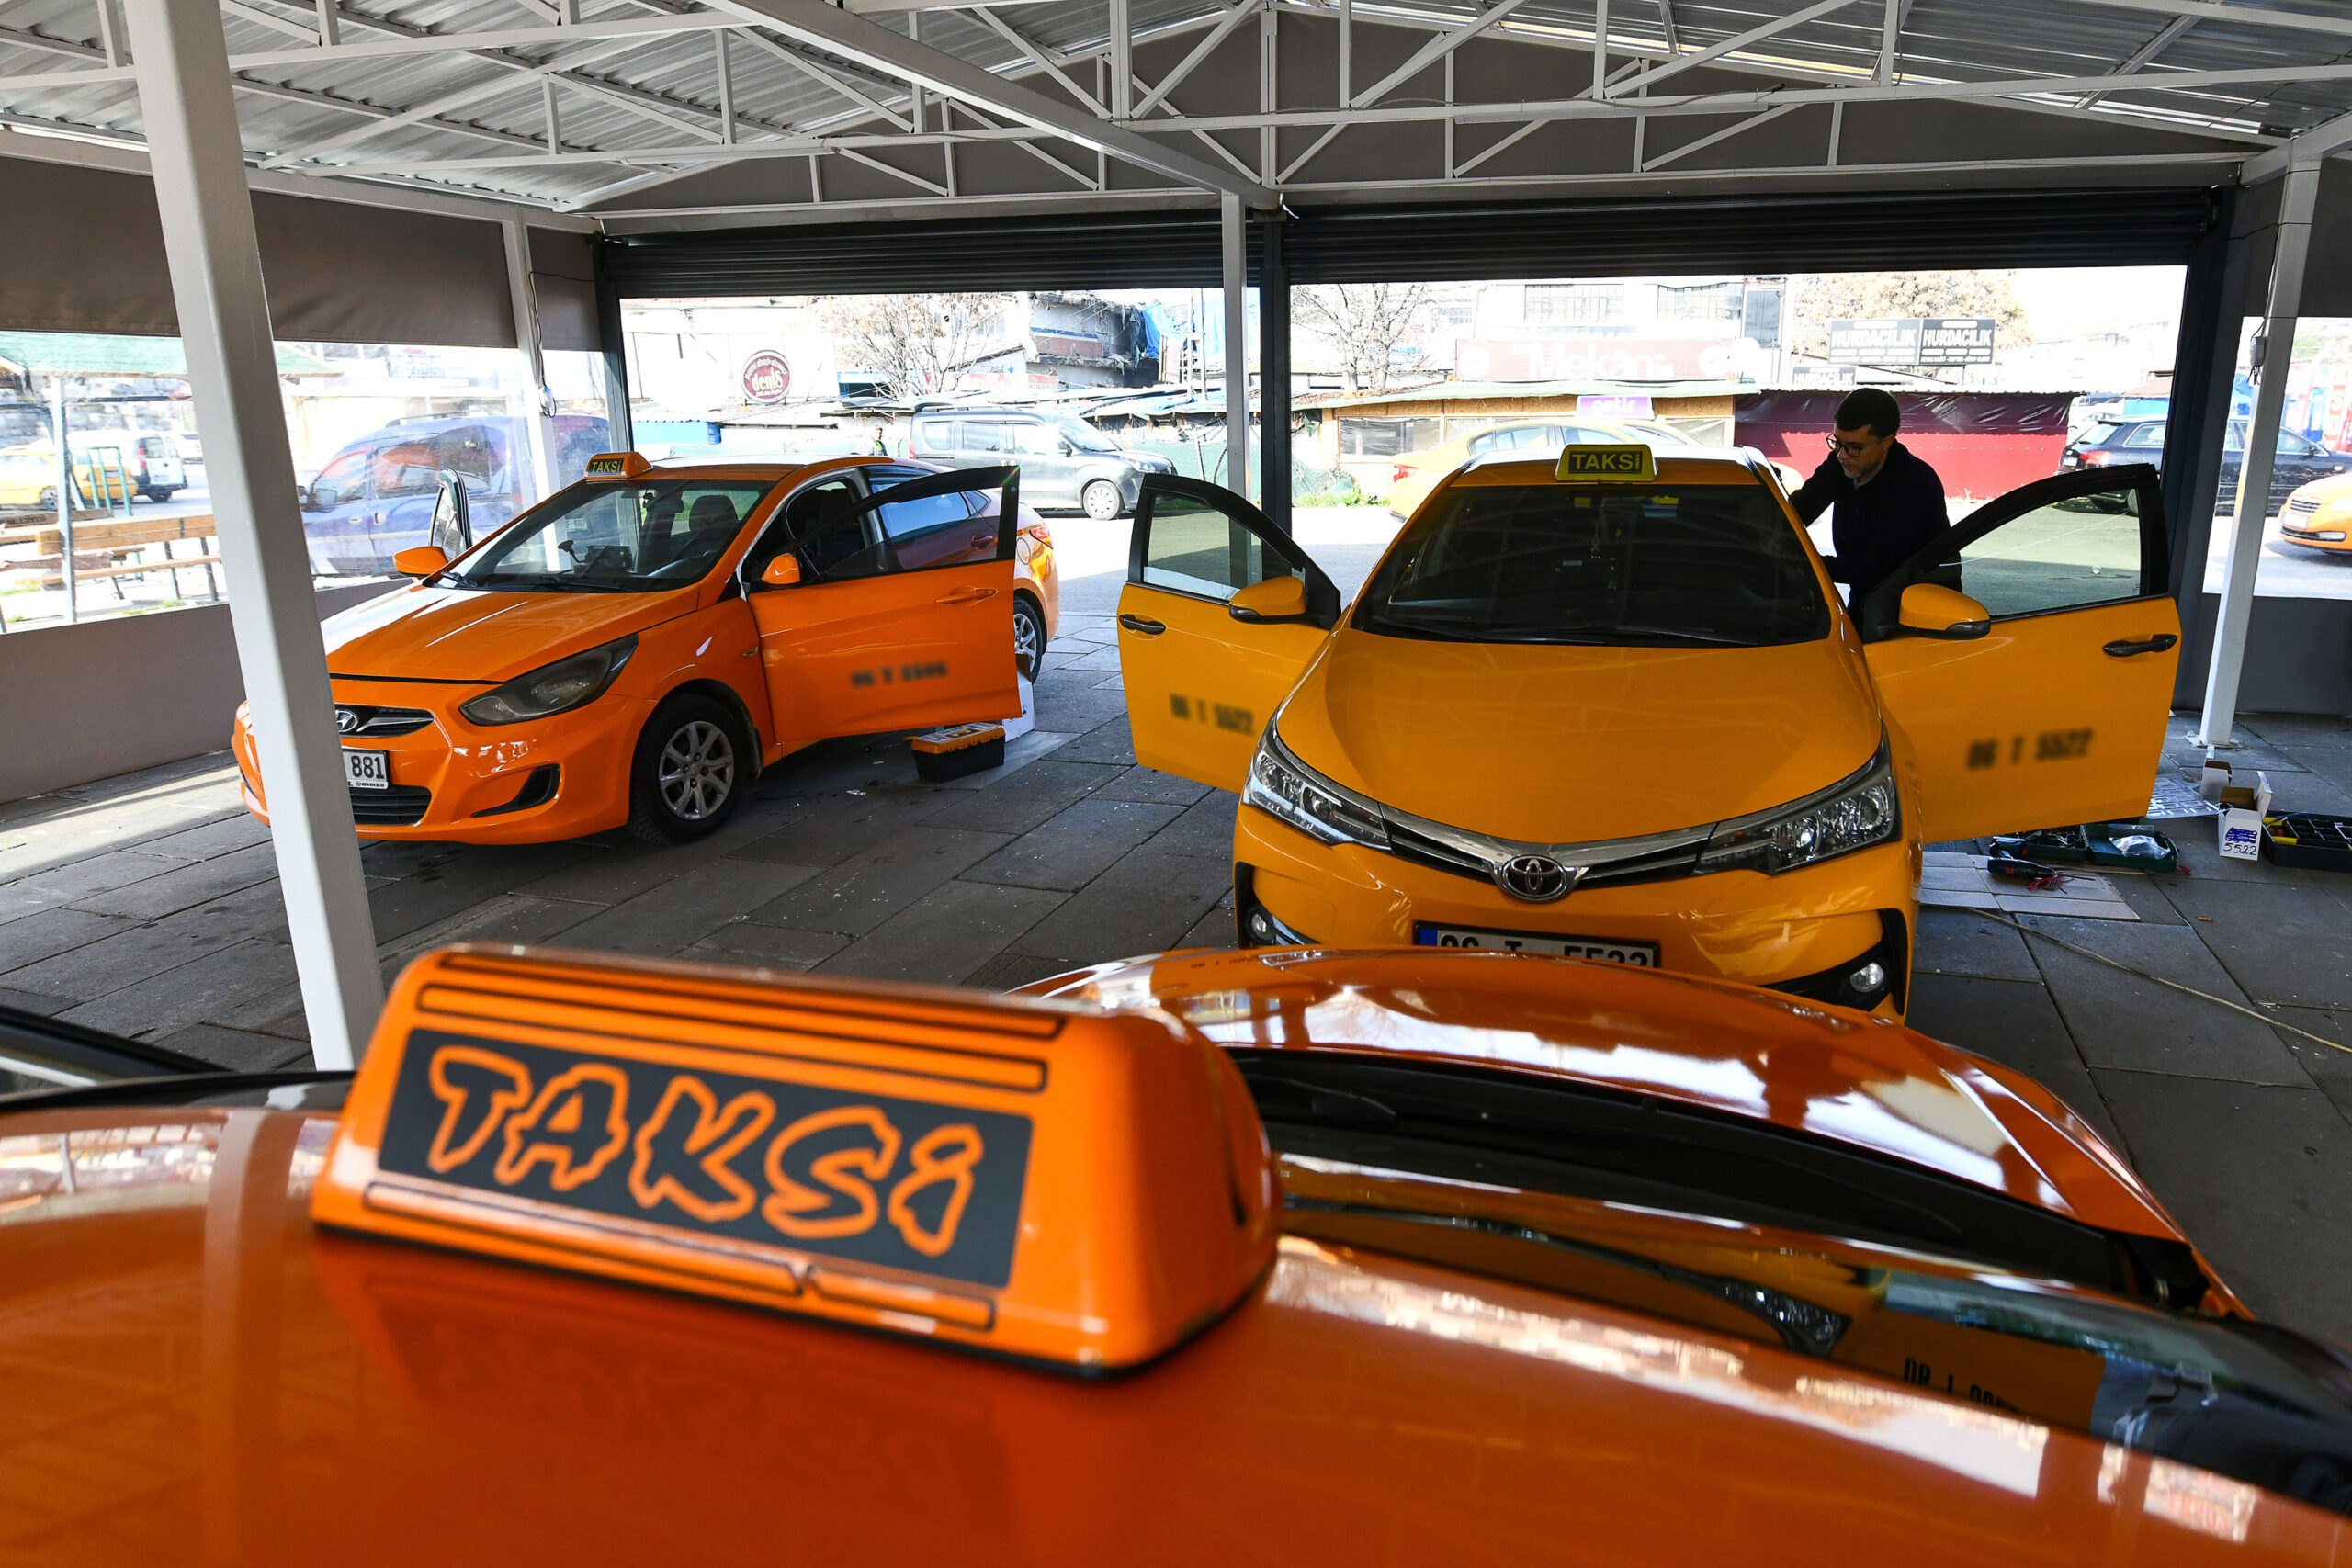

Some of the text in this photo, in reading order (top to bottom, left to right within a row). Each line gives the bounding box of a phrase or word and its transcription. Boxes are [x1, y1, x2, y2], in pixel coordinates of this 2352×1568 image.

[1831, 329, 1917, 347] HURDACILIK
[1922, 329, 1993, 347] HURDACILIK
[351, 755, 384, 779] 881
[2223, 842, 2257, 856] 5522
